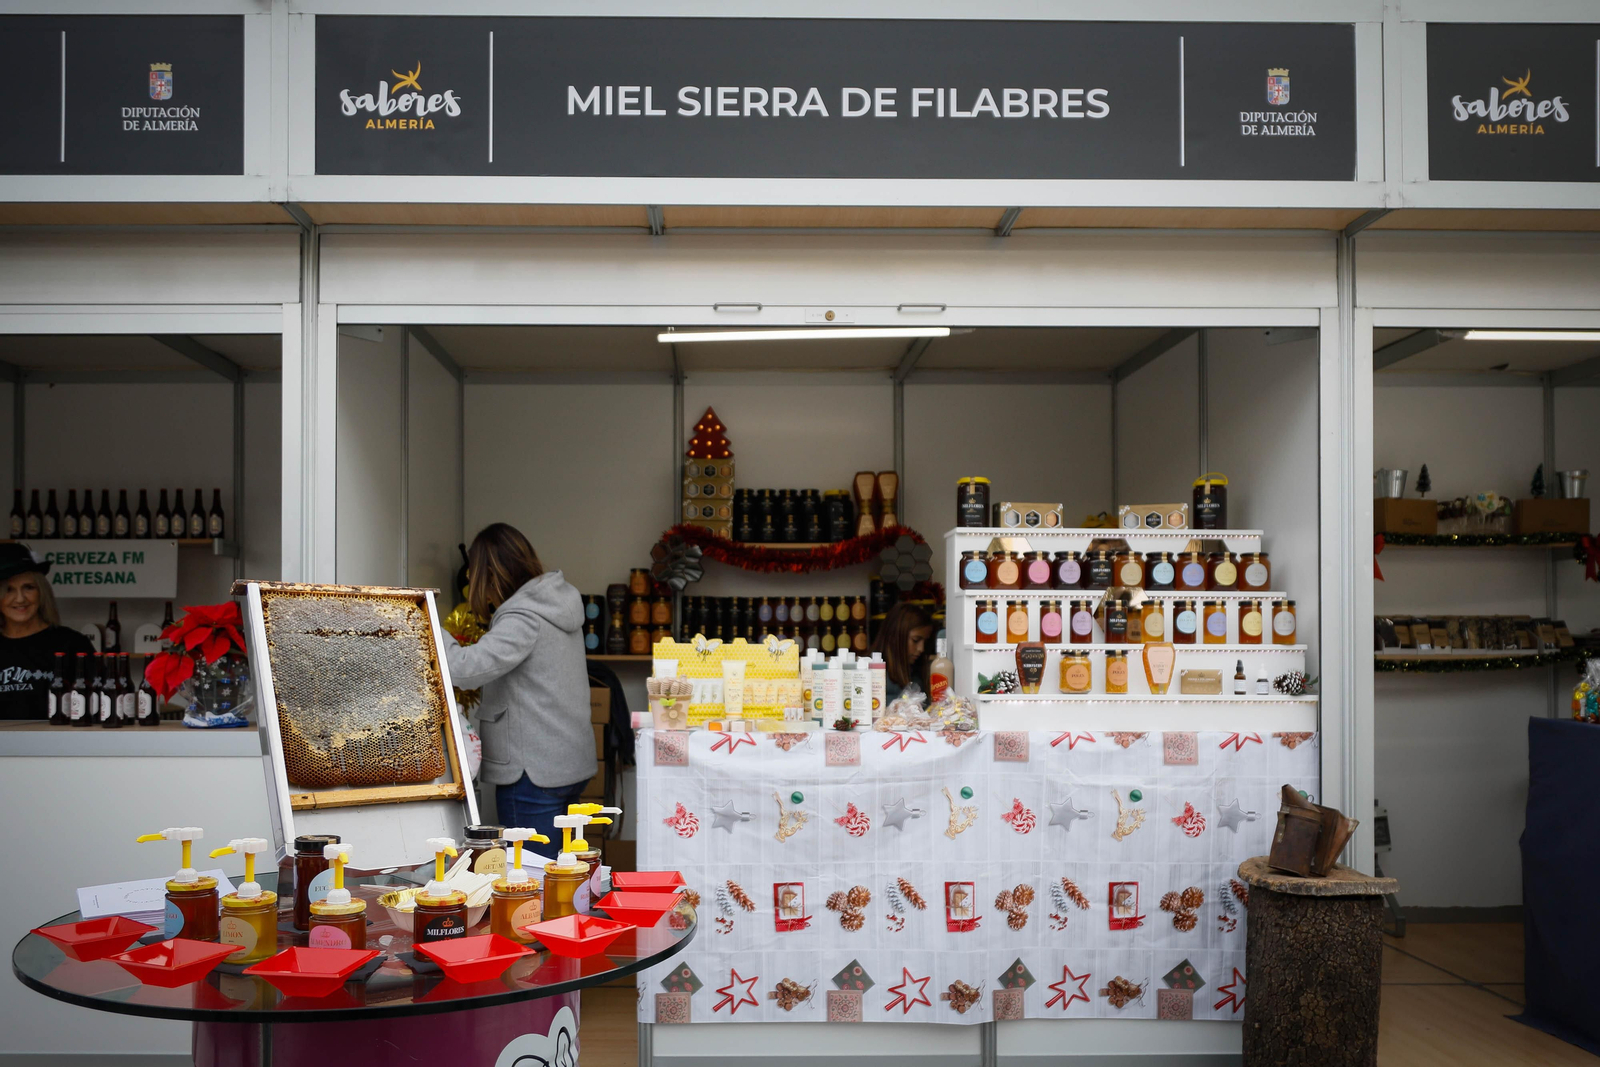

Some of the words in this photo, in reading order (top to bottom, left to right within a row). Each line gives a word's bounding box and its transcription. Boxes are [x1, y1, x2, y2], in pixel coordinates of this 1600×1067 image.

[339, 80, 462, 118] sabores
[567, 85, 667, 117] MIEL
[677, 85, 830, 118] SIERRA
[841, 86, 898, 118] DE
[911, 86, 1110, 119] FILABRES
[1451, 86, 1570, 123] sabores
[121, 104, 201, 119] DIPUTACIÓN
[1239, 109, 1318, 125] DIPUTACIÓN
[123, 119, 141, 132] DE
[142, 118, 199, 132] ALMERÍA
[365, 117, 436, 130] ALMERÍA
[1241, 124, 1259, 136] DE
[1260, 122, 1316, 137] ALMERÍA
[1477, 122, 1545, 135] ALMERÍA
[45, 551, 118, 565] CERVEZA
[122, 551, 144, 565] FM
[52, 571, 137, 585] ARTESANA
[0, 683, 34, 692] ERVEZA
[426, 926, 465, 936] MILFLORES
